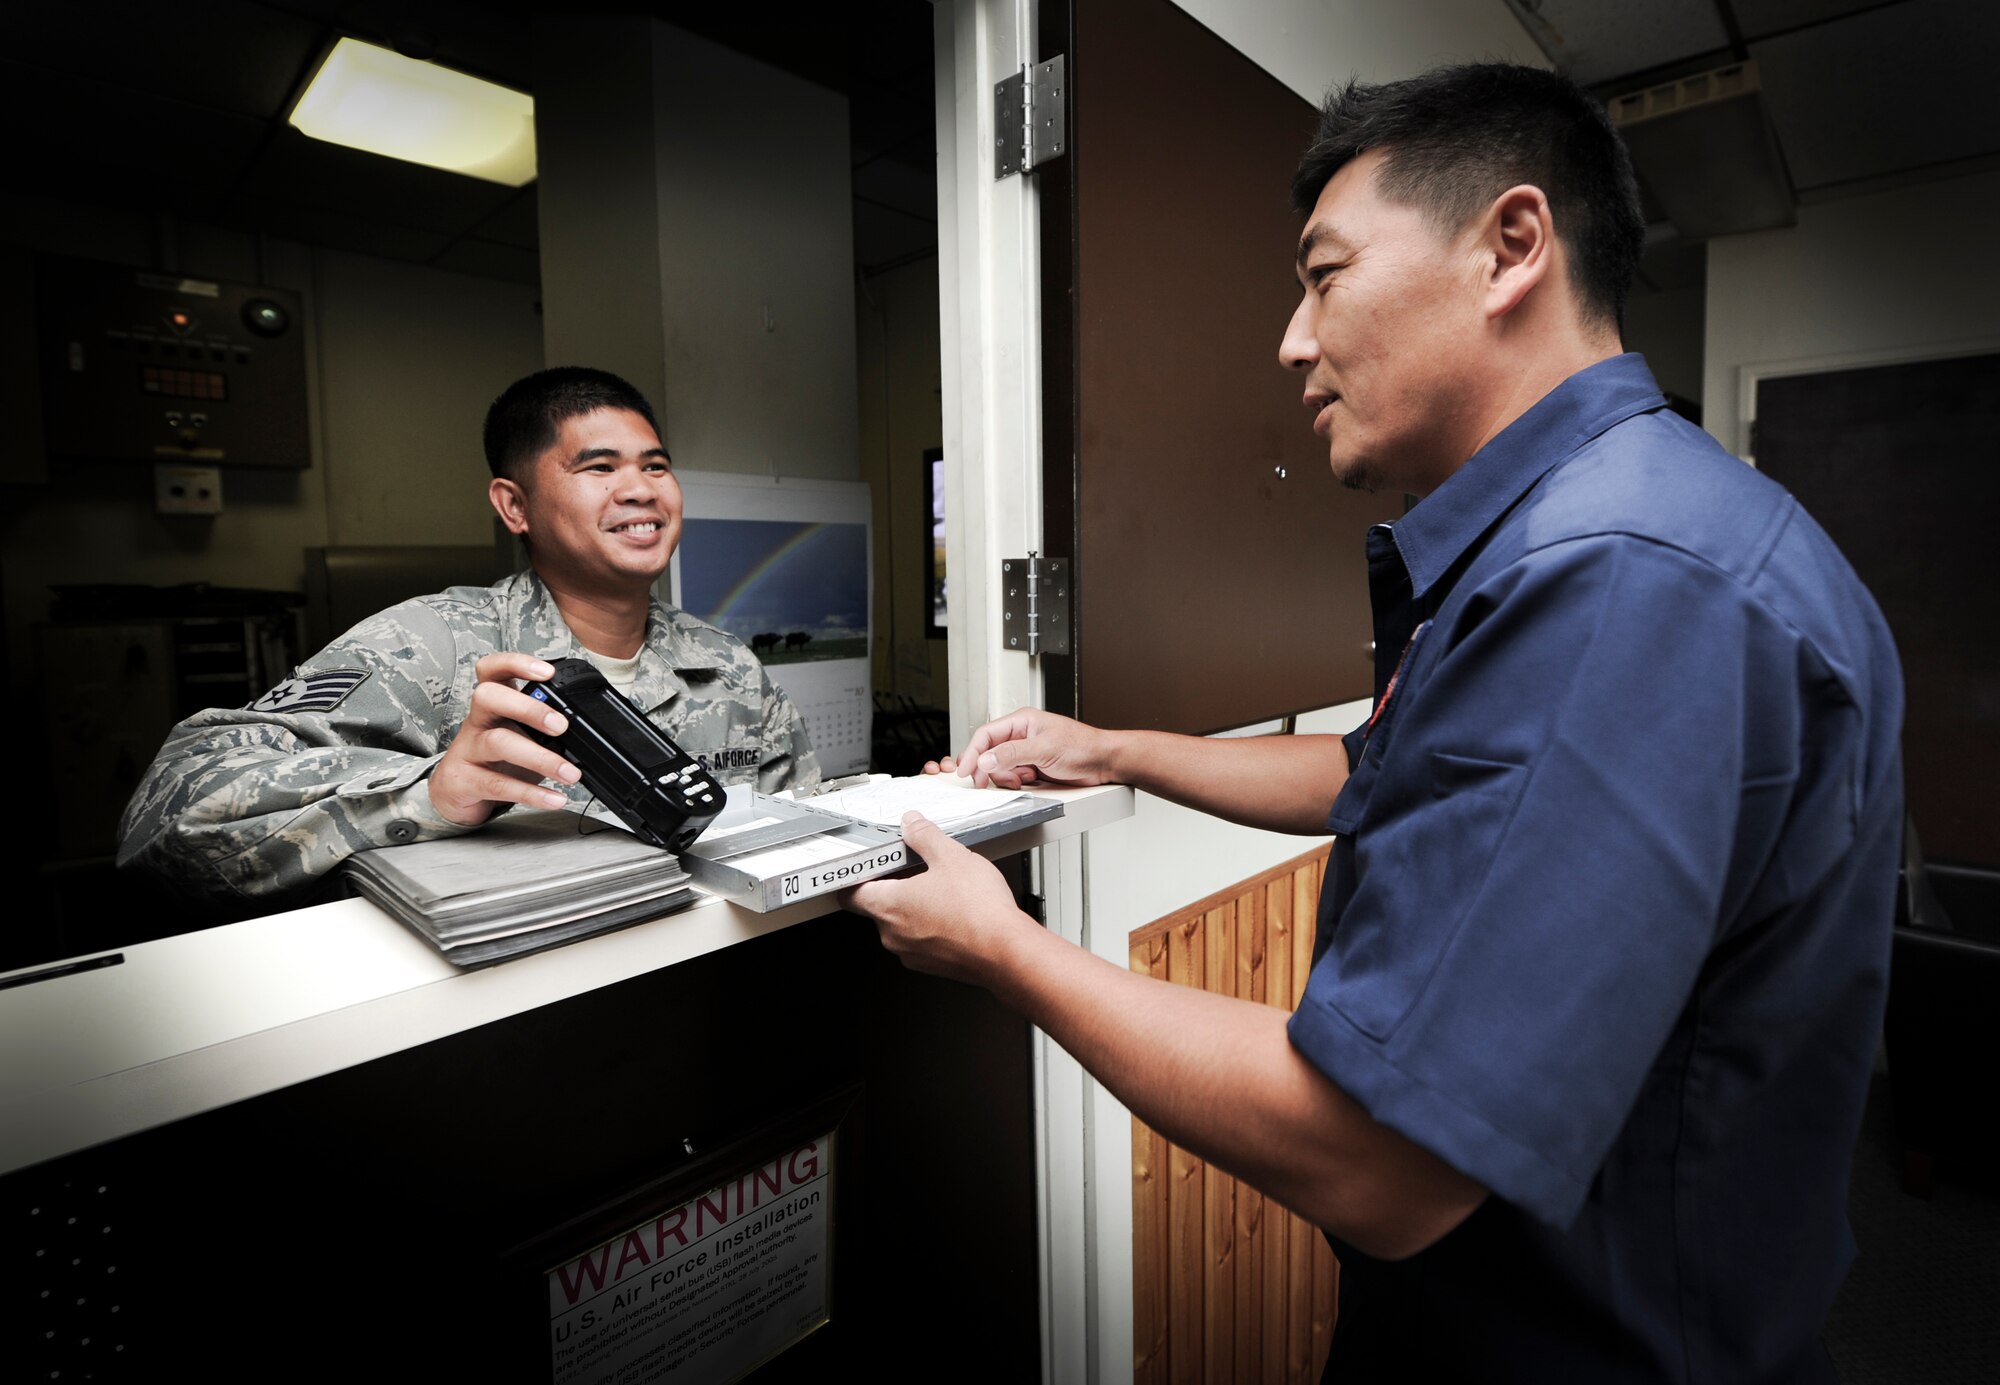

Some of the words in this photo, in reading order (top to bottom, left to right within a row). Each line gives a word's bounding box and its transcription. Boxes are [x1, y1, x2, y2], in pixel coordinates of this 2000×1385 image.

[784, 875, 800, 897] D2
[810, 850, 903, 888] 06L0651
[555, 1310, 603, 1343] U.S.
[611, 1286, 642, 1314] Air
[651, 1251, 708, 1292] Force
[715, 1190, 820, 1257] Installation
[556, 1140, 819, 1306] WARNING
[554, 1345, 575, 1359] The
[578, 1333, 597, 1347] use
[599, 1324, 609, 1335] of
[612, 1298, 657, 1327] universal
[660, 1282, 685, 1302] serial
[688, 1274, 704, 1286] bus
[706, 1257, 731, 1277] (USB)
[733, 1244, 753, 1260] flash
[756, 1230, 780, 1247] media
[783, 1212, 813, 1233] devices
[555, 1359, 574, 1373] are
[577, 1327, 627, 1363] prohibited
[630, 1306, 666, 1330] without
[669, 1276, 719, 1309] Designated
[721, 1254, 757, 1279] Approval
[759, 1234, 797, 1257] Authority.
[616, 1344, 665, 1376] processes
[667, 1316, 710, 1345] classified
[713, 1287, 763, 1318] information.
[767, 1277, 773, 1286] If
[804, 1253, 817, 1265] any
[641, 1355, 664, 1372] flash
[667, 1337, 695, 1358] media
[697, 1319, 725, 1339] device
[728, 1307, 742, 1320] will
[745, 1301, 754, 1311] be
[757, 1284, 782, 1304] seized
[795, 1270, 807, 1280] the
[644, 1355, 686, 1383] manager
[688, 1348, 697, 1357] or
[699, 1326, 734, 1351] Security
[737, 1308, 763, 1327] Forces
[766, 1283, 807, 1311] personnel.
